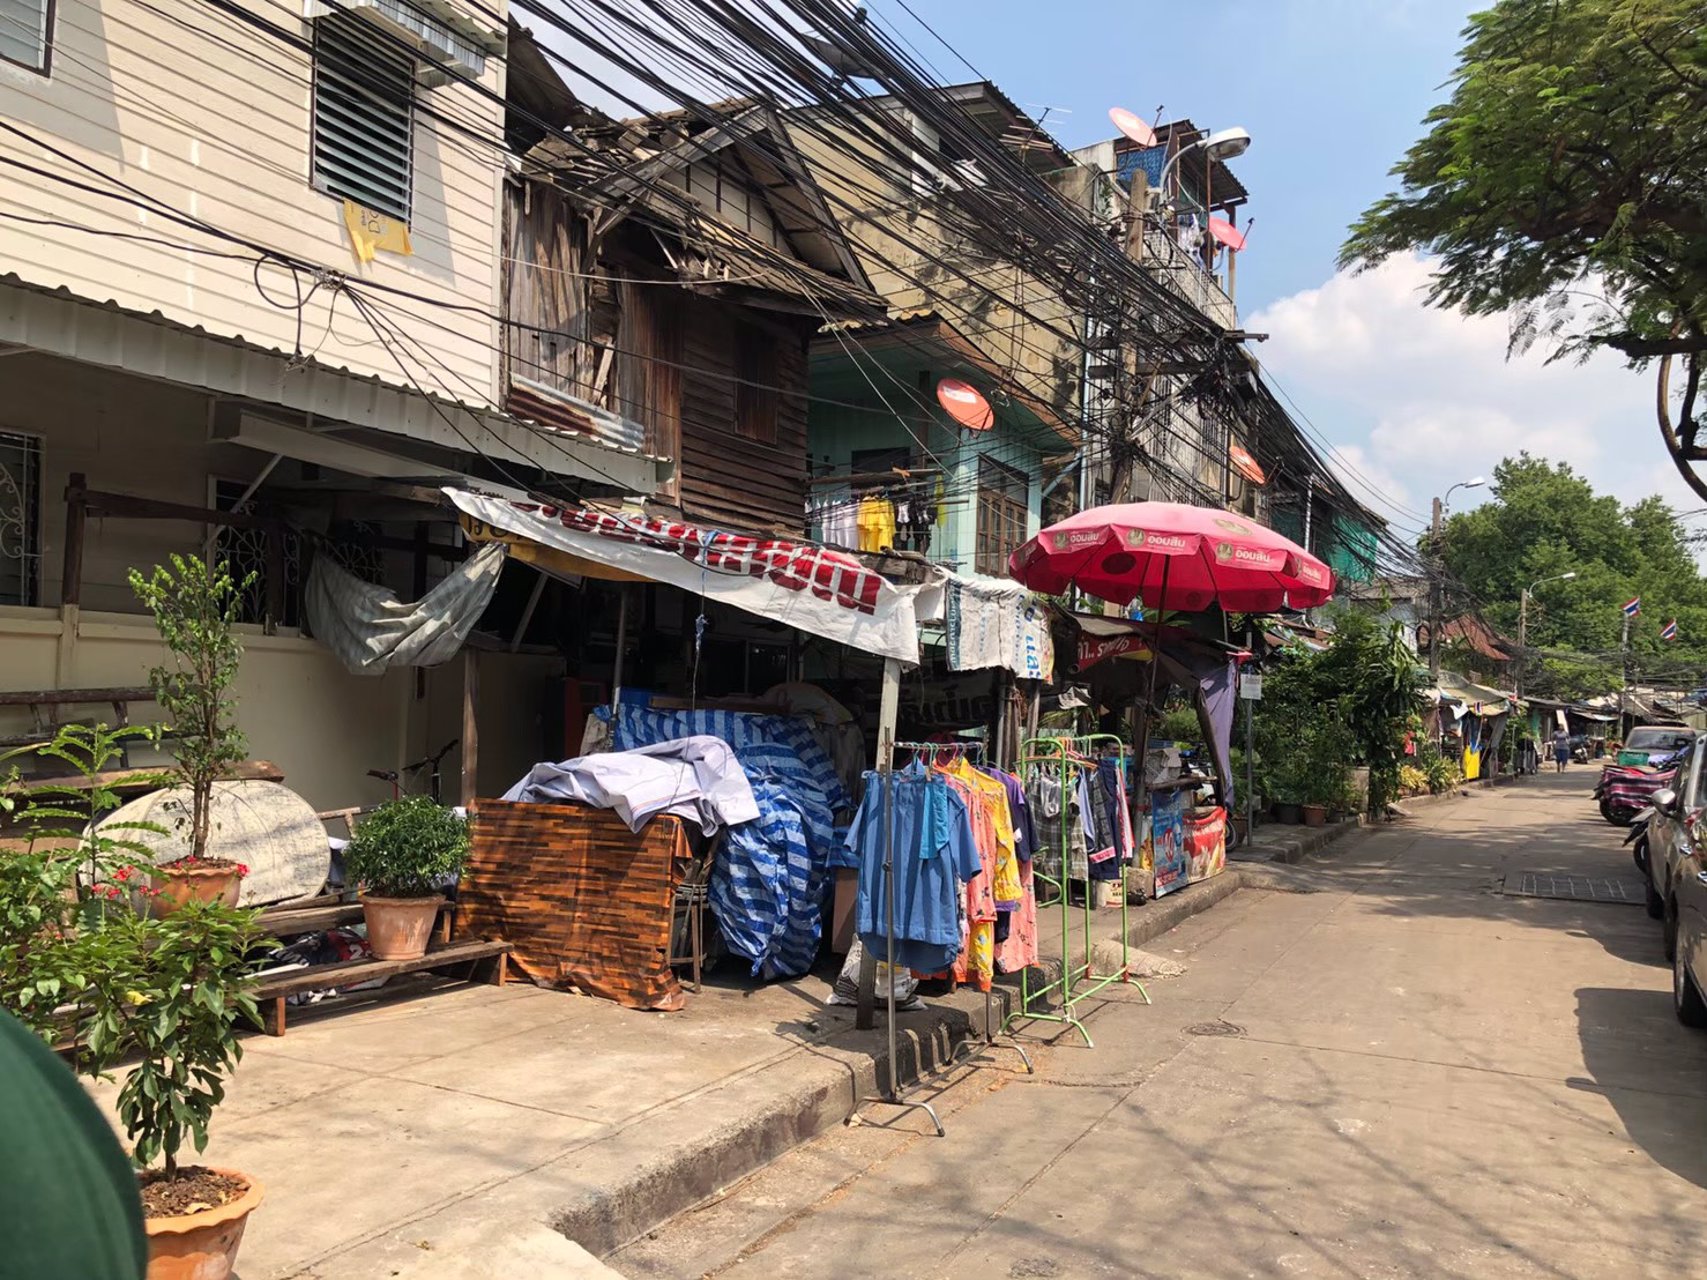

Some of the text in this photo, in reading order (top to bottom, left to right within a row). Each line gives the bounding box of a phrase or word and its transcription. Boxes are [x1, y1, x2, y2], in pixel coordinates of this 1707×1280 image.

[1147, 535, 1186, 548] ออมสิน
[1235, 548, 1271, 561] ออมสิน
